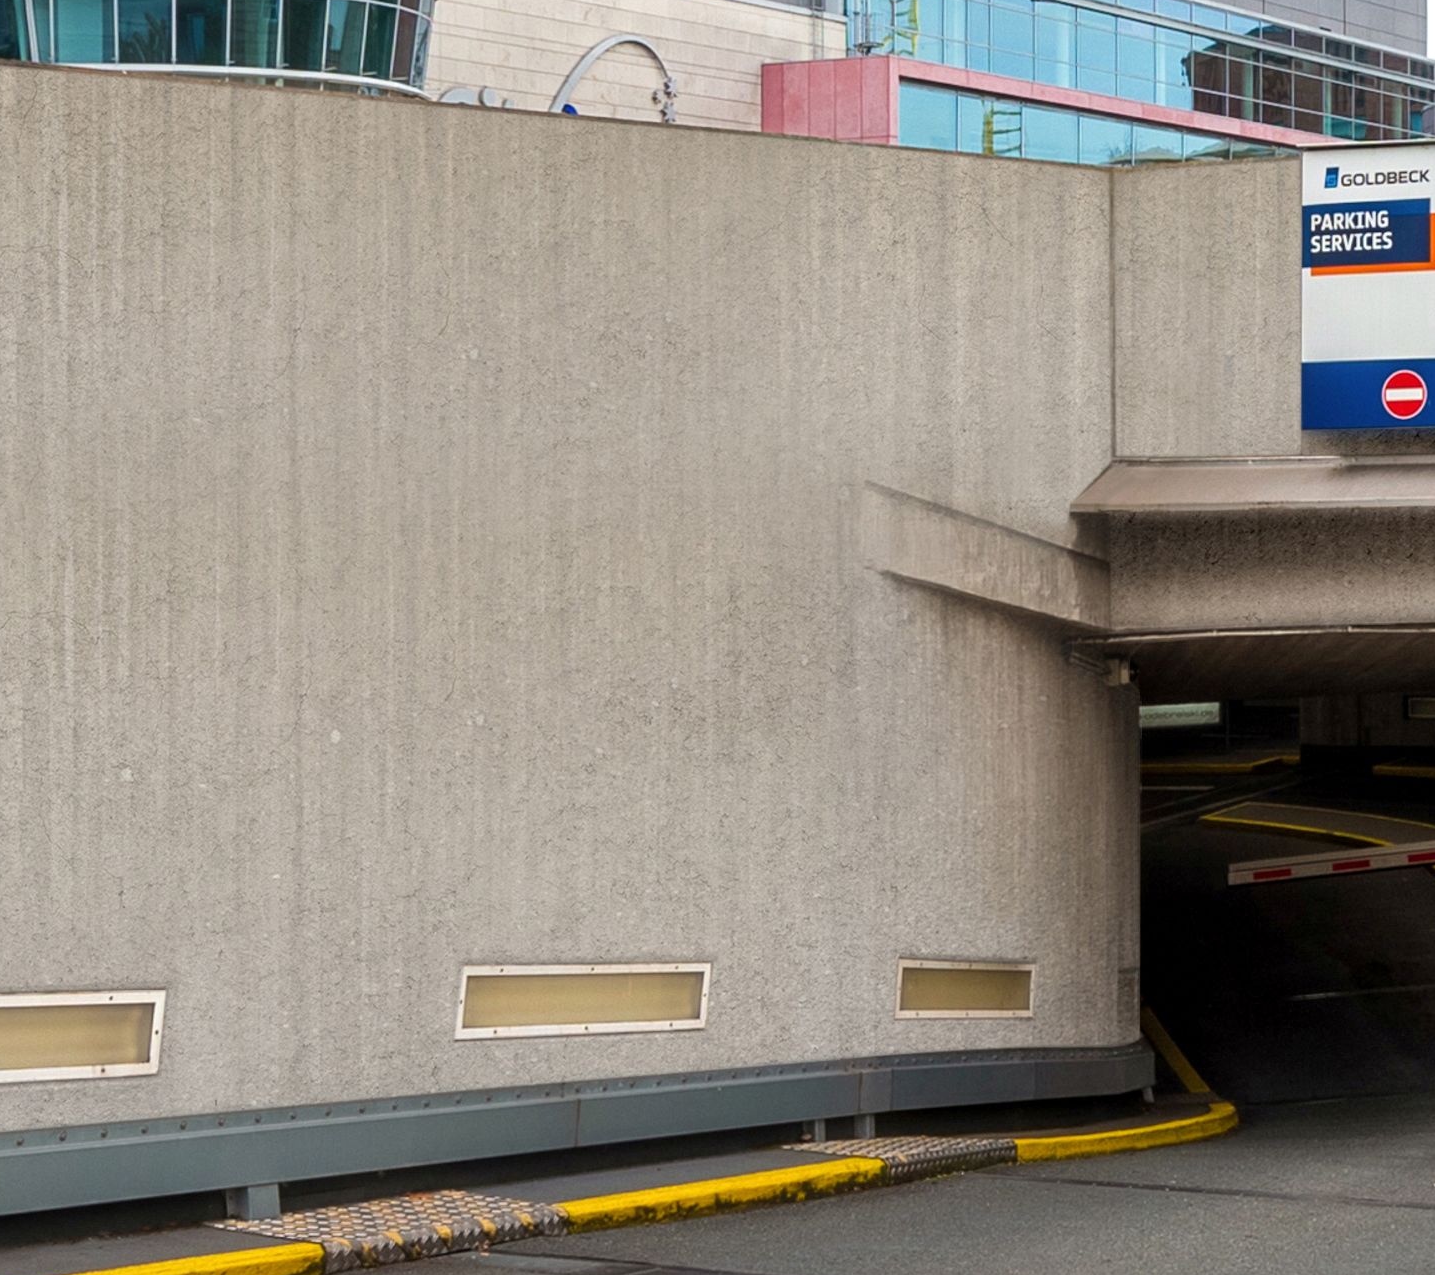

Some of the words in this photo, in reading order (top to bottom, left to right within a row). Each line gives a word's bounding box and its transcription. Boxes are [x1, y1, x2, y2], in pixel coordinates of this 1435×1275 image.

[1340, 169, 1430, 187] GOLDBECK
[1310, 210, 1390, 232] PARKING
[1310, 231, 1394, 254] SERVICES
